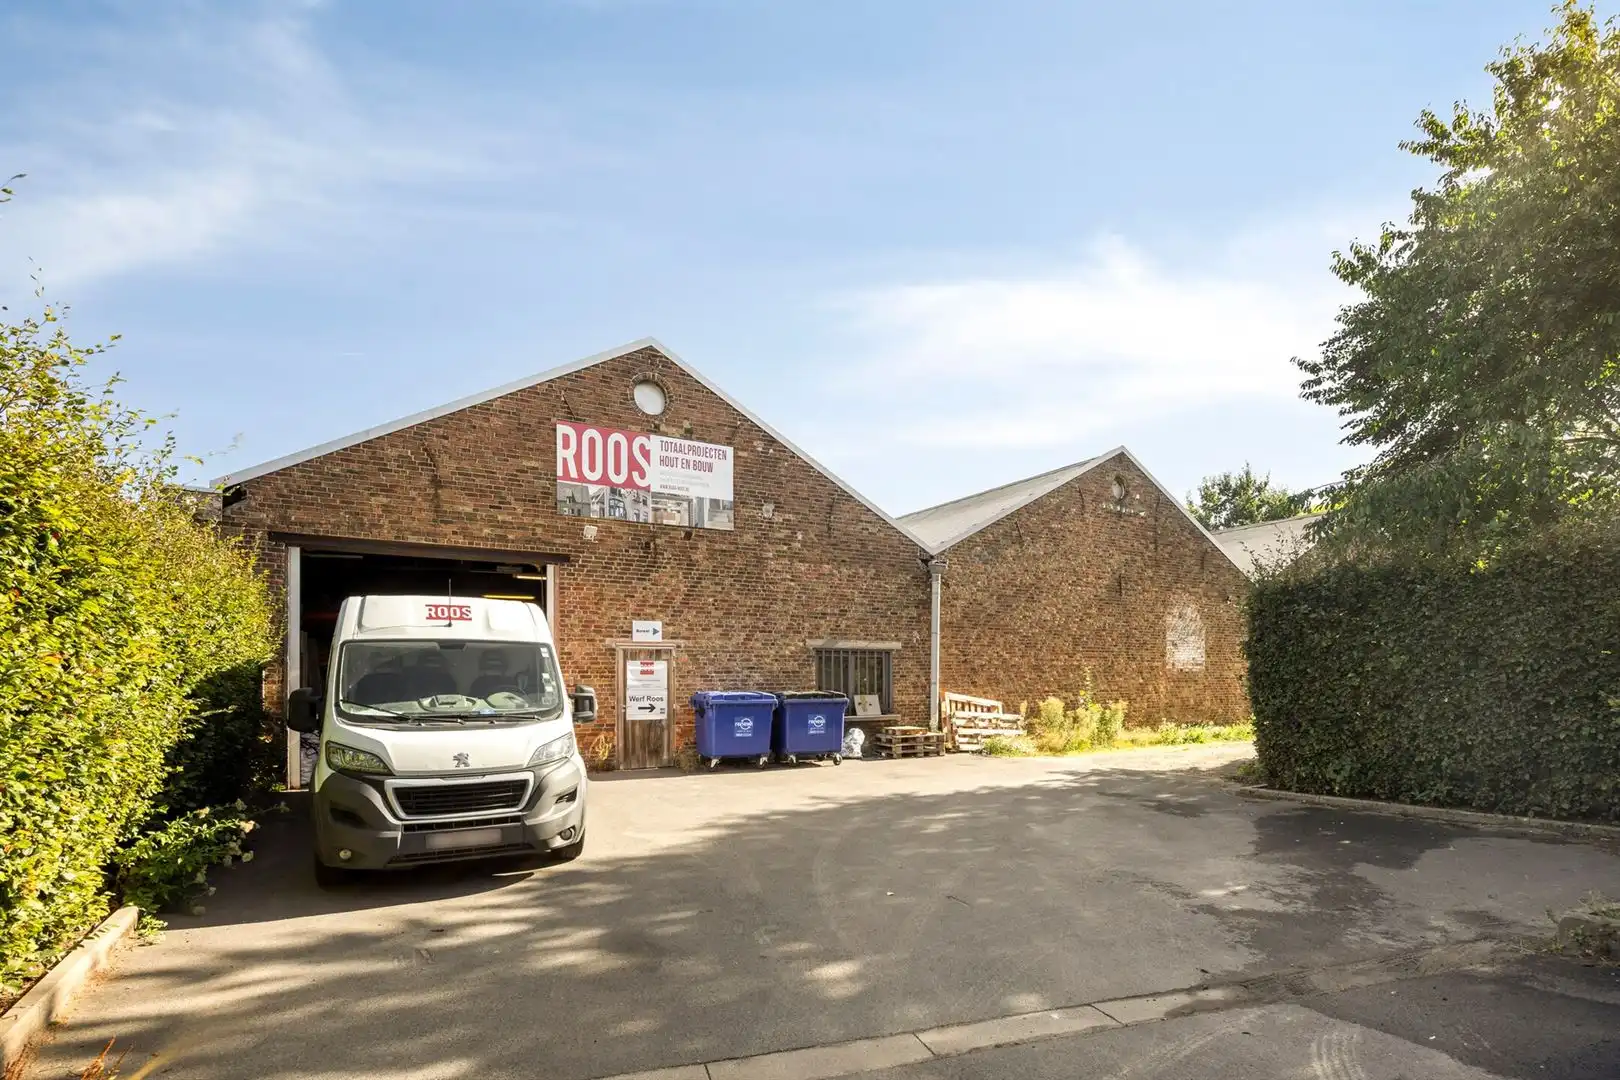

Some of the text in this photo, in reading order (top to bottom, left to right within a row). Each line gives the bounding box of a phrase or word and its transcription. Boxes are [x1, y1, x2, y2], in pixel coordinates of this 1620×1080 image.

[557, 424, 650, 487] ROOS
[660, 440, 727, 460] TOTAALPROJECTEN
[660, 455, 713, 472] HOUT EN BOUW
[427, 606, 472, 619] ROOS
